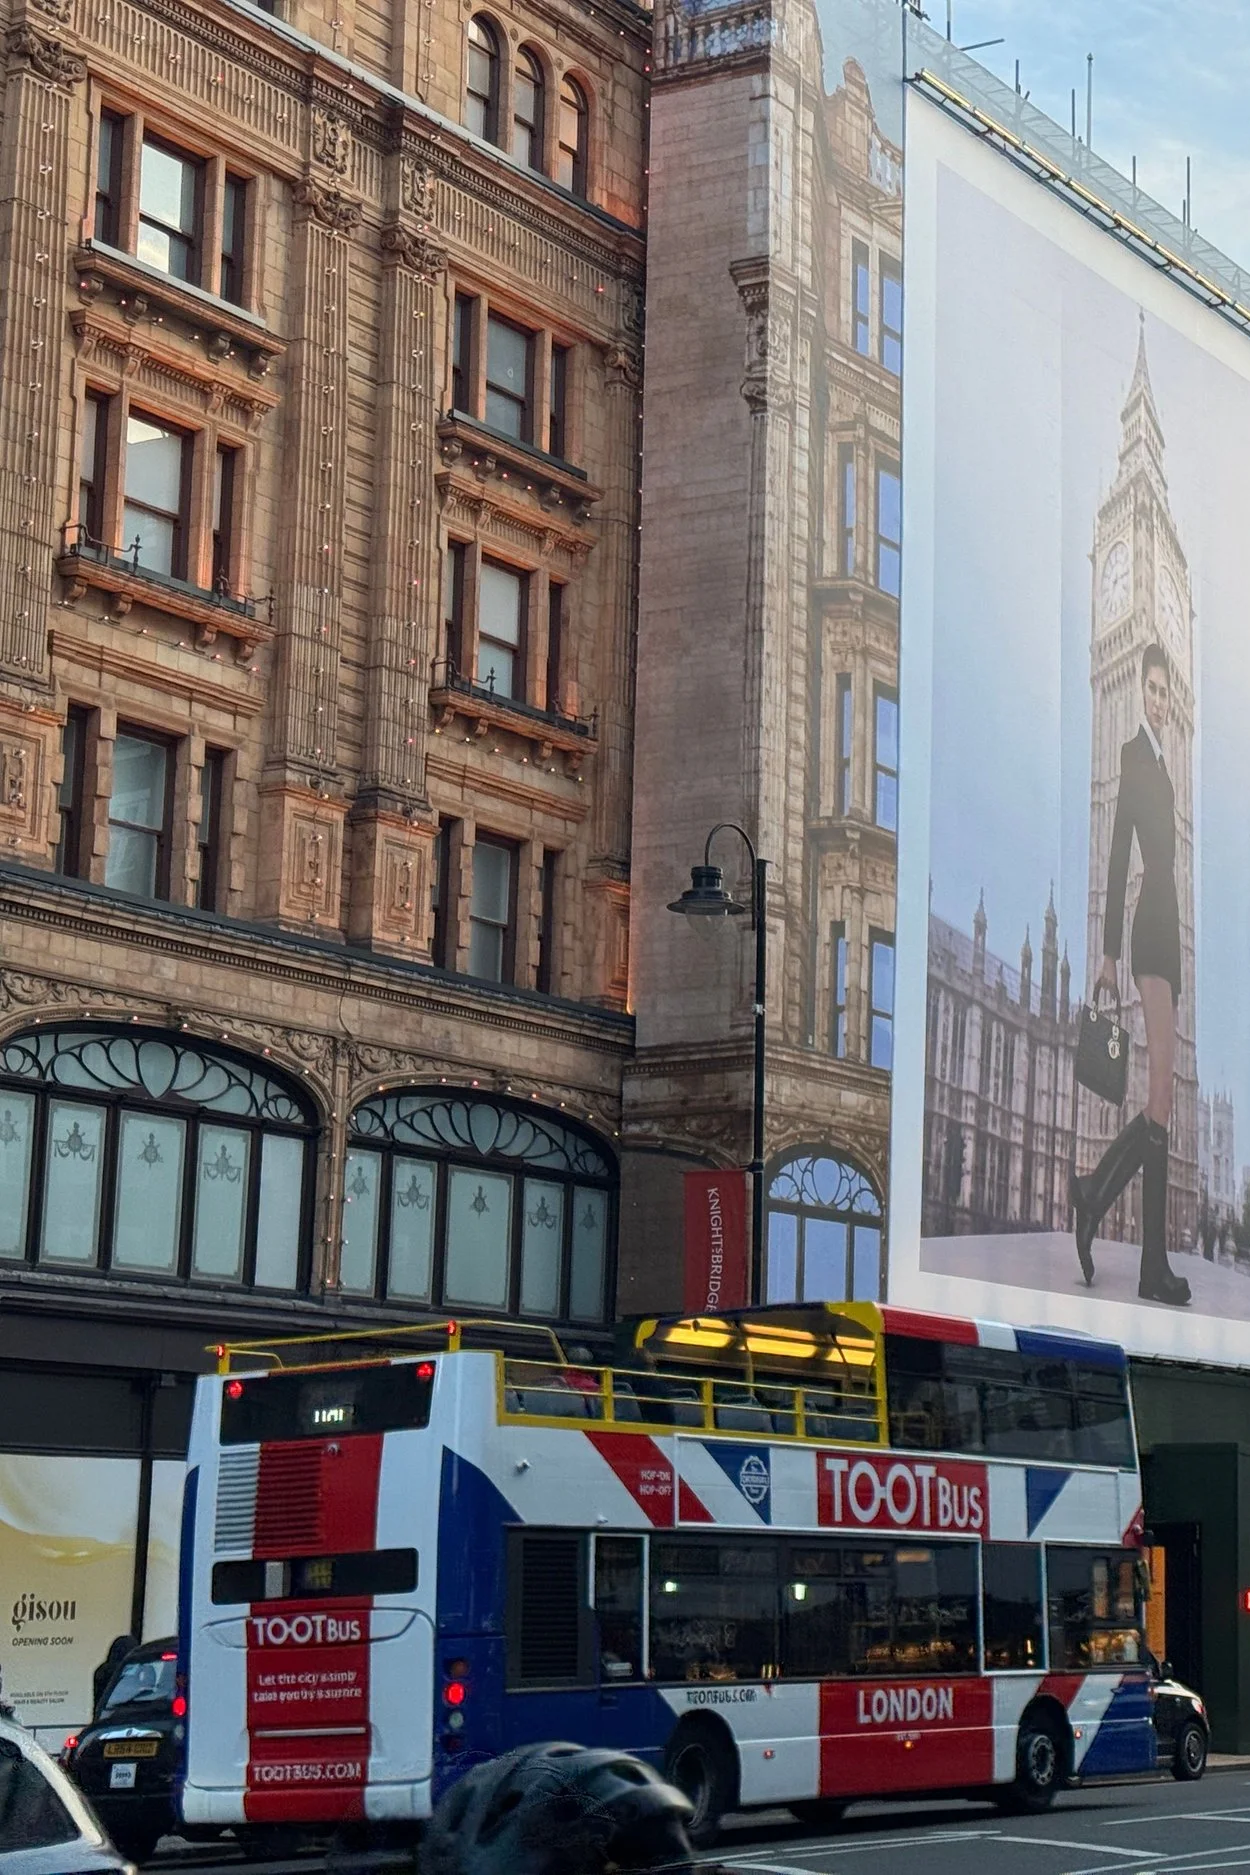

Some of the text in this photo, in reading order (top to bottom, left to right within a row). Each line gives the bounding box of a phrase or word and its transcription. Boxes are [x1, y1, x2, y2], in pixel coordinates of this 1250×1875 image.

[640, 1470, 671, 1482] HOP-ON
[639, 1484, 672, 1496] HOP-OFF
[12, 1593, 76, 1632] gisou
[12, 1636, 74, 1647] OPENING SOON
[857, 1687, 954, 1724] LONDON
[253, 1762, 362, 1783] TOOTBUS.COM
